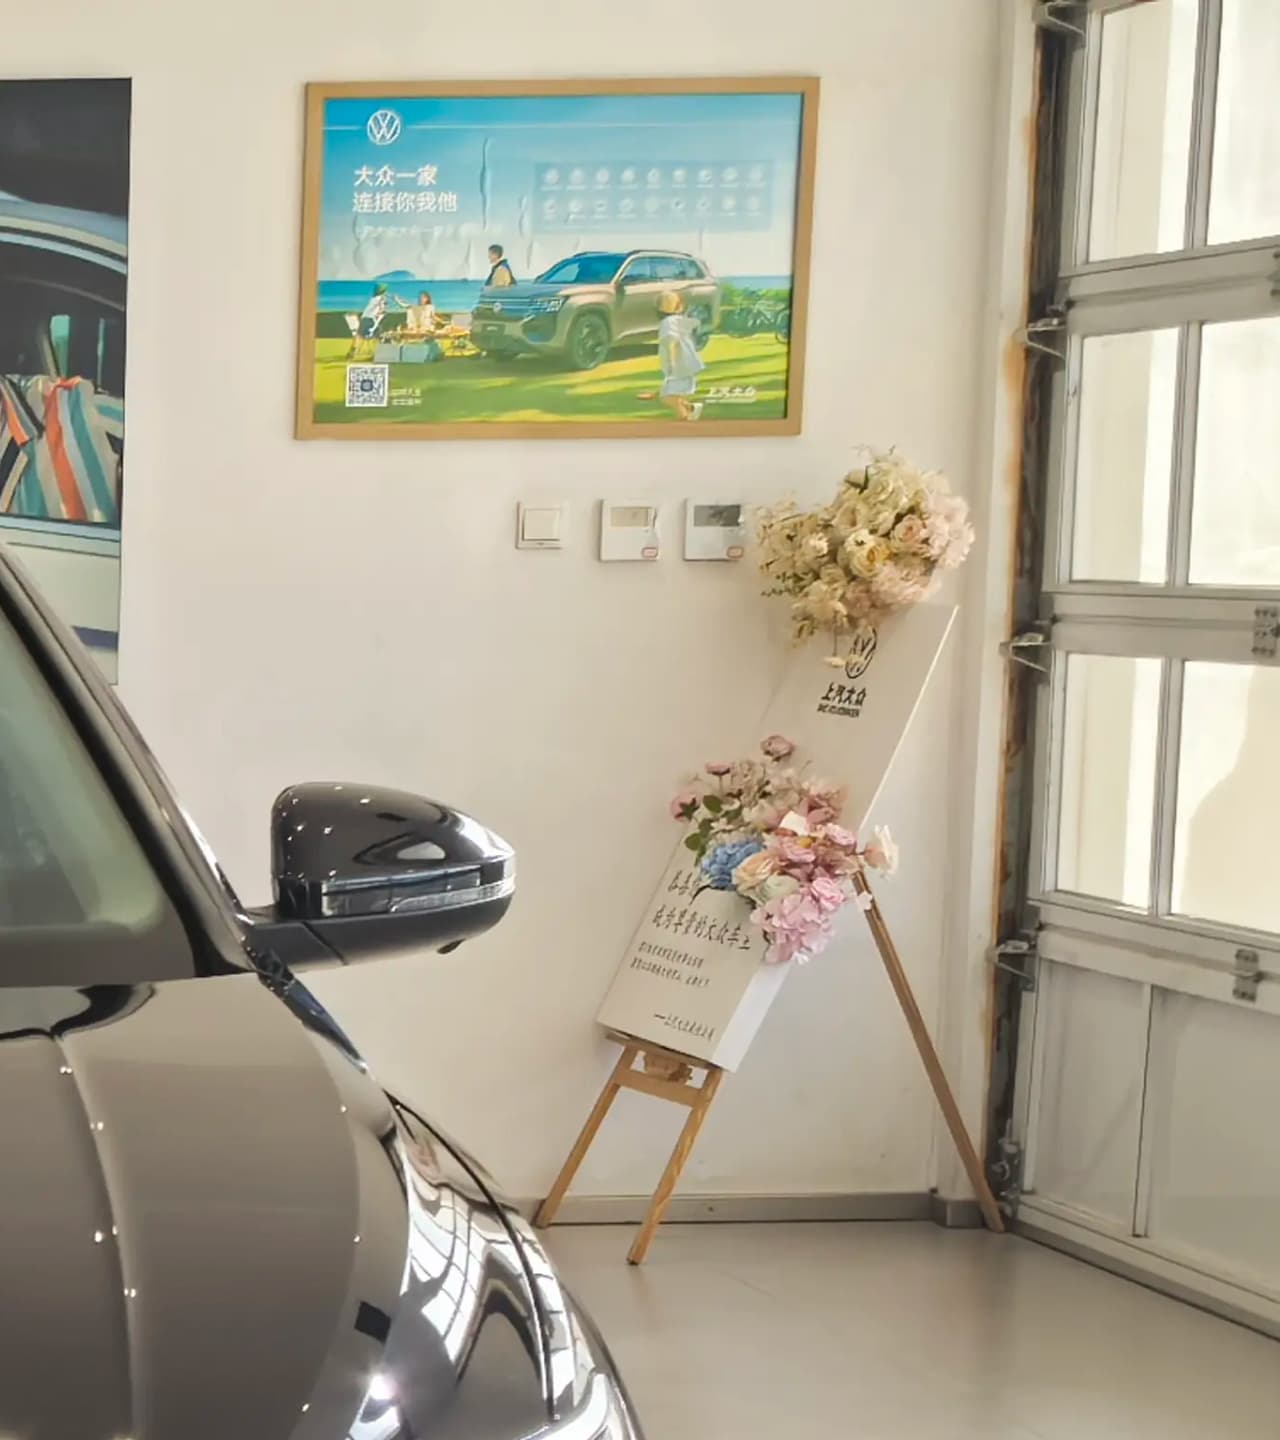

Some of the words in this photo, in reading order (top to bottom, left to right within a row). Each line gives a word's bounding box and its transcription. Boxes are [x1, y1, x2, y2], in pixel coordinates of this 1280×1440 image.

[353, 164, 438, 187] 大众一家
[352, 191, 457, 213] 连接你我他
